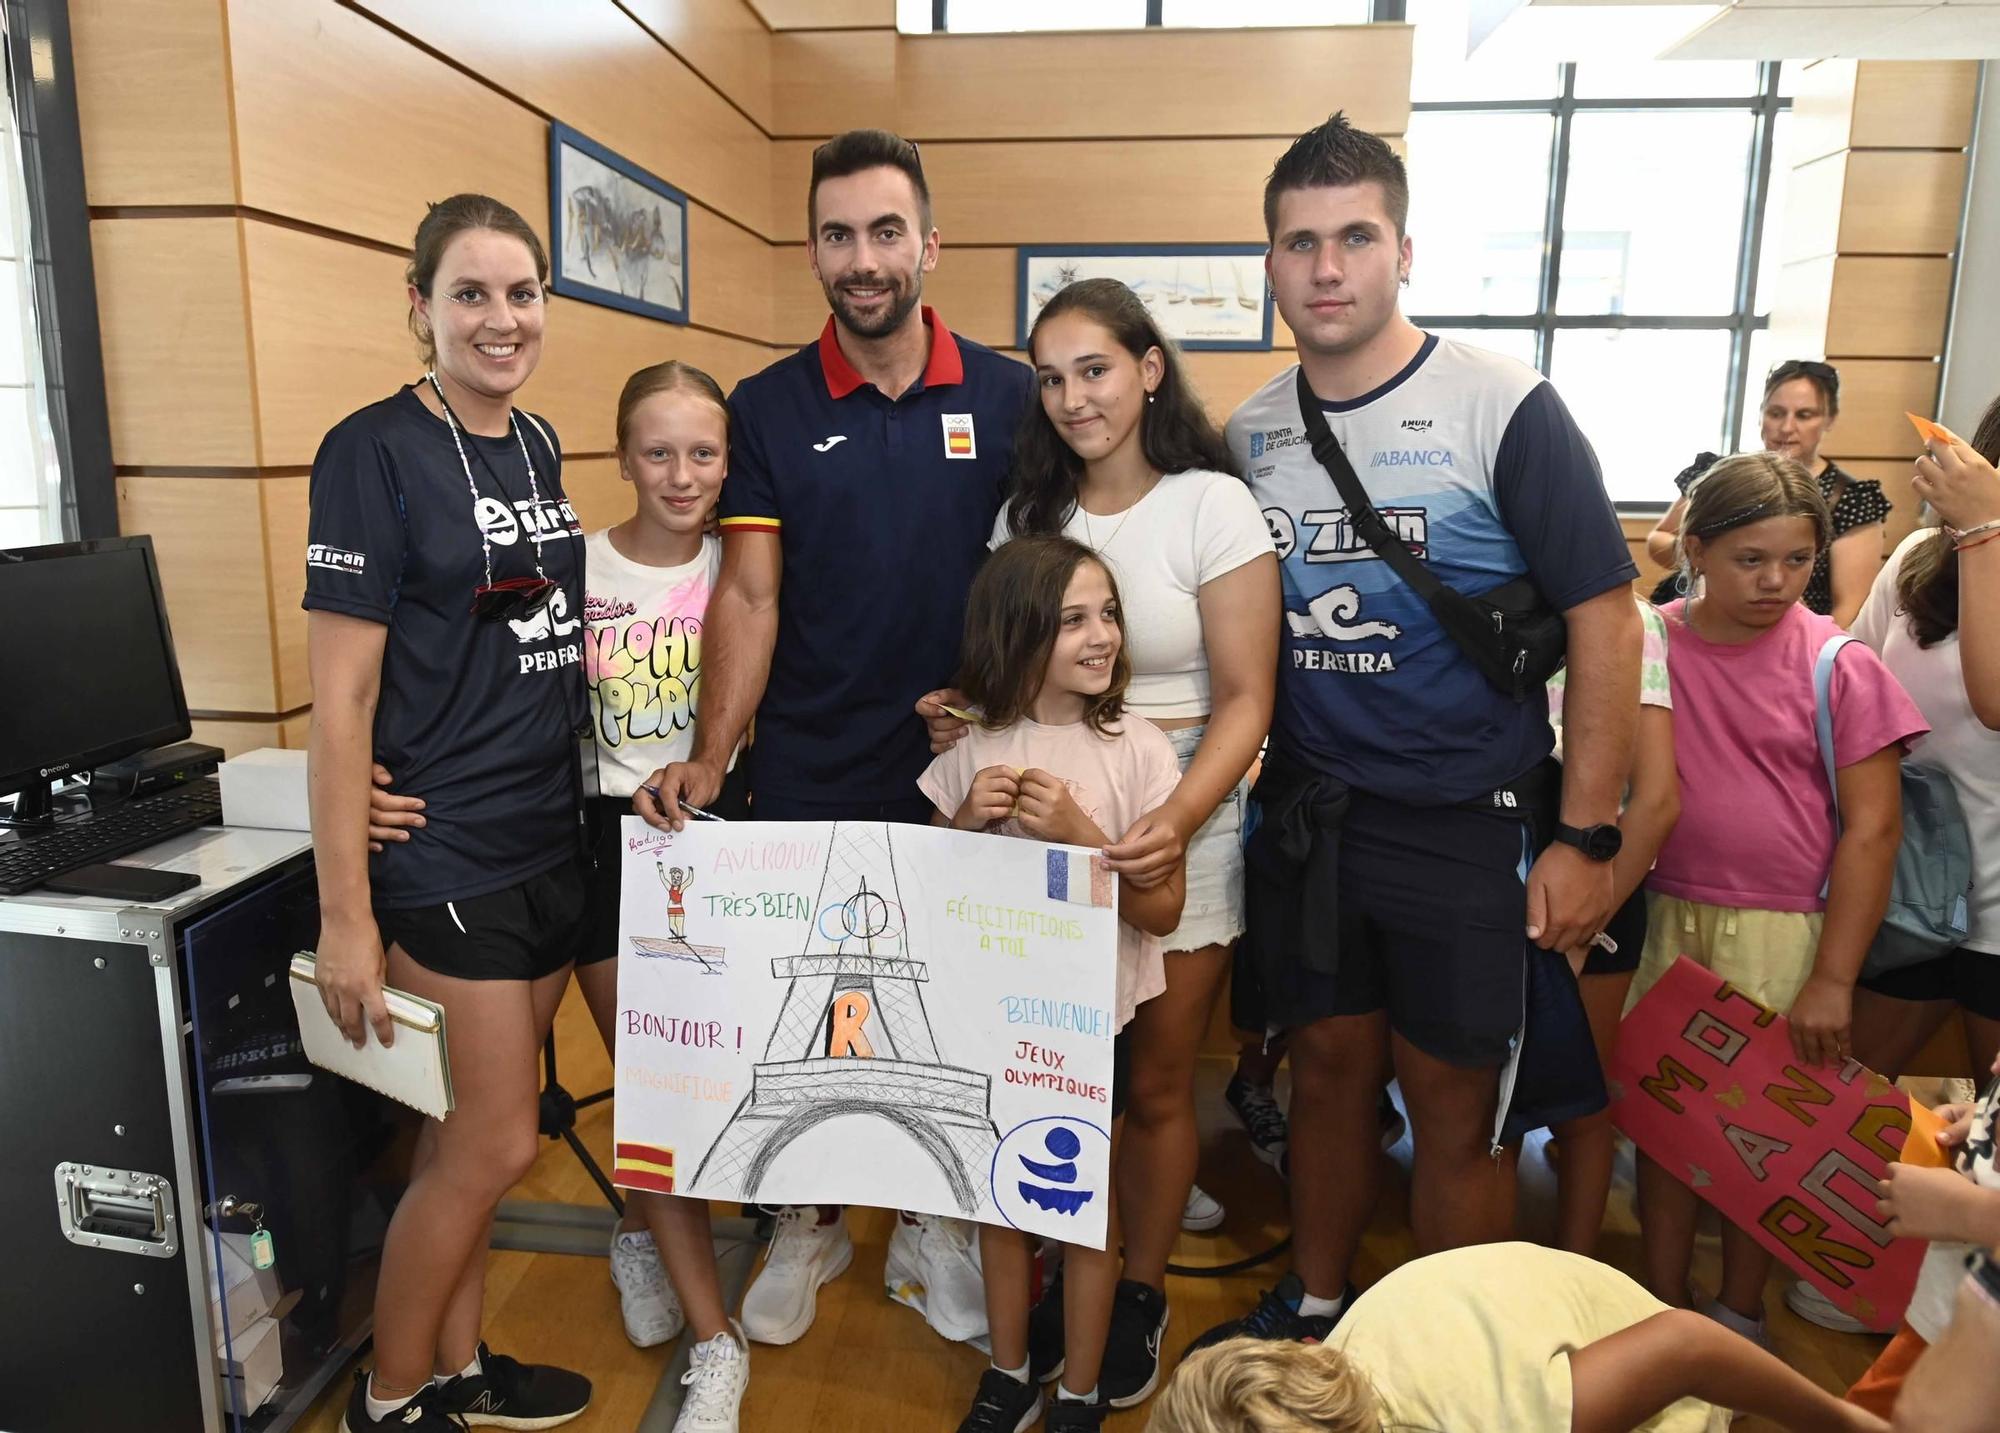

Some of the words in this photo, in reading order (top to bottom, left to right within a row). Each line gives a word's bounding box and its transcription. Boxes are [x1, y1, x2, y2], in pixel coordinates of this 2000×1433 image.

[1266, 427, 1293, 441] XUNTA
[1401, 420, 1433, 428] AMURA
[1265, 442, 1276, 452] DE
[1293, 649, 1396, 674] PEREIRA
[701, 891, 757, 917] TRÈS
[756, 892, 810, 921] BIEN
[946, 895, 1084, 940] FÉLICITATIONS
[995, 936, 1031, 959] TOI
[825, 991, 876, 1058] R
[998, 996, 1110, 1041] BIENVENUE!
[1015, 1041, 1066, 1071] JEUX
[624, 1064, 734, 1104] MAGNIFIQUE
[1004, 1068, 1107, 1103] OLYMPIQUES
